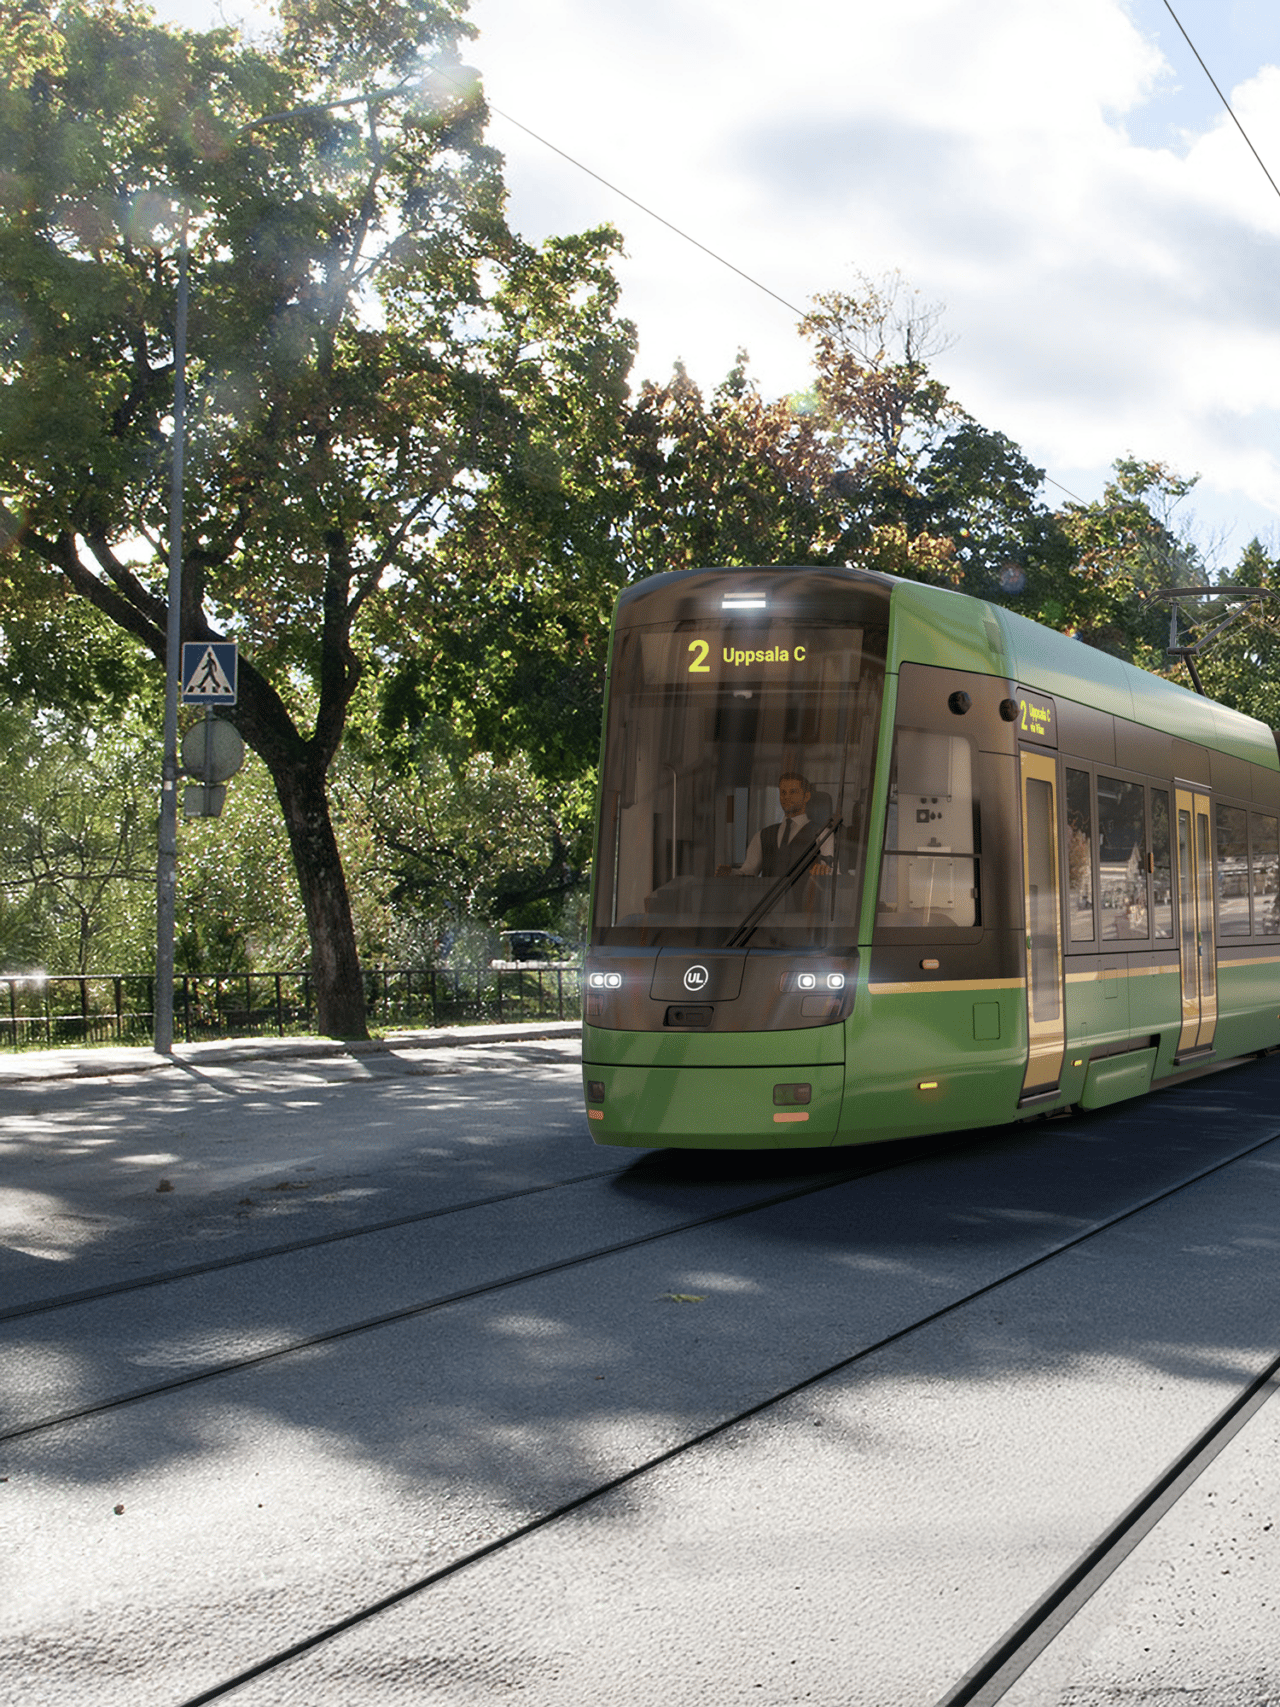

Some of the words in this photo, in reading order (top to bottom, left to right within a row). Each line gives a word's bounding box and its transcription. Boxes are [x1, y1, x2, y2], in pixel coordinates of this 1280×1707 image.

[688, 639, 710, 672] 2
[723, 645, 789, 666] Uppsala
[793, 645, 806, 662] C
[1020, 700, 1028, 731] 2
[688, 972, 703, 984] UL
